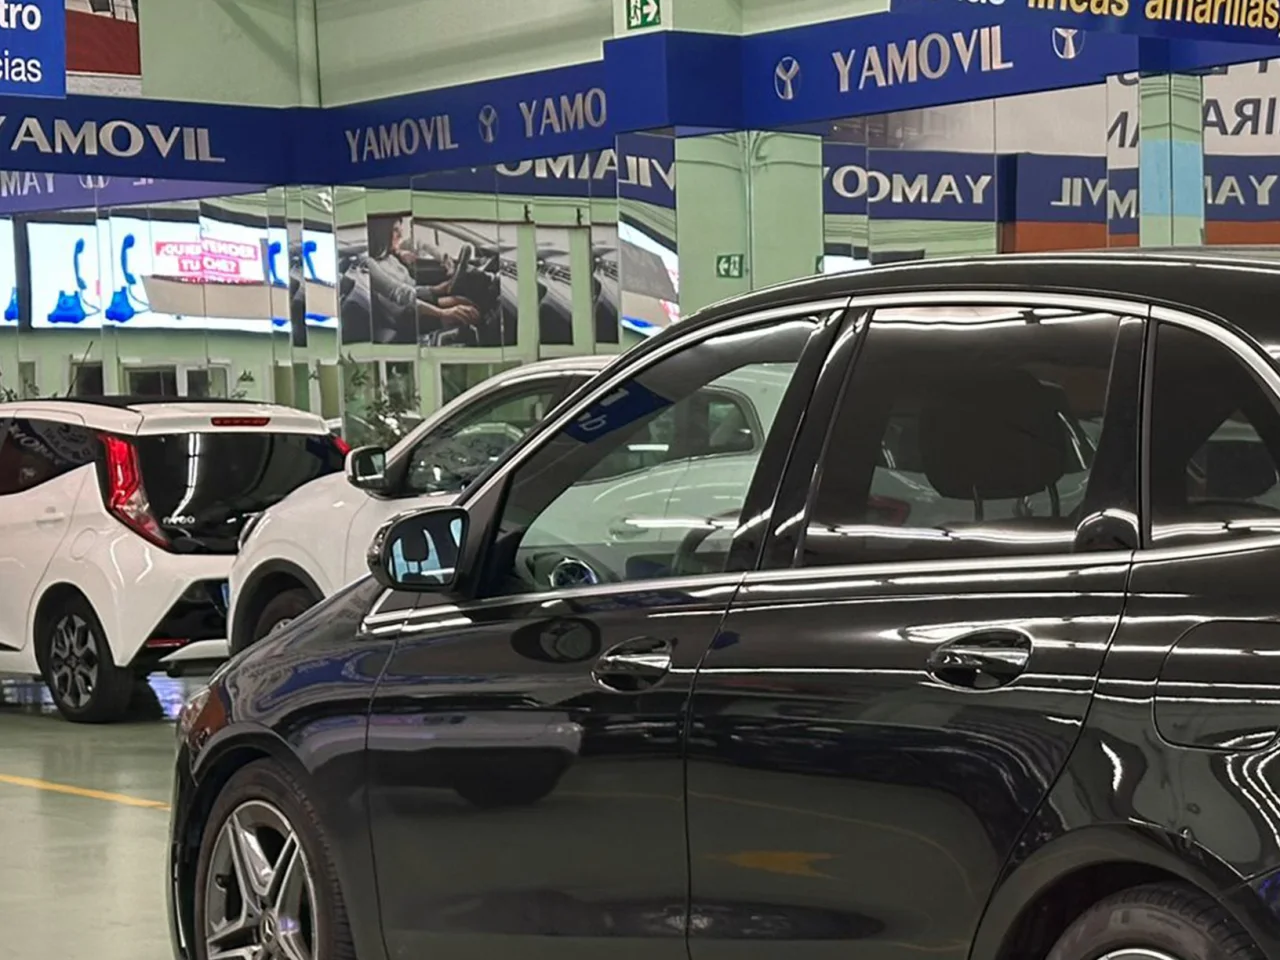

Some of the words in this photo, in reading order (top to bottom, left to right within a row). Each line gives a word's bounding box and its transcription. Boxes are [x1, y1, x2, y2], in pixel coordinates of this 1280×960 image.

[0, 50, 42, 83] ias
[832, 26, 1014, 92] YAMOVIL
[519, 87, 608, 138] YAMO
[0, 116, 226, 163] AMOVIL
[345, 114, 459, 163] YAMOVIL
